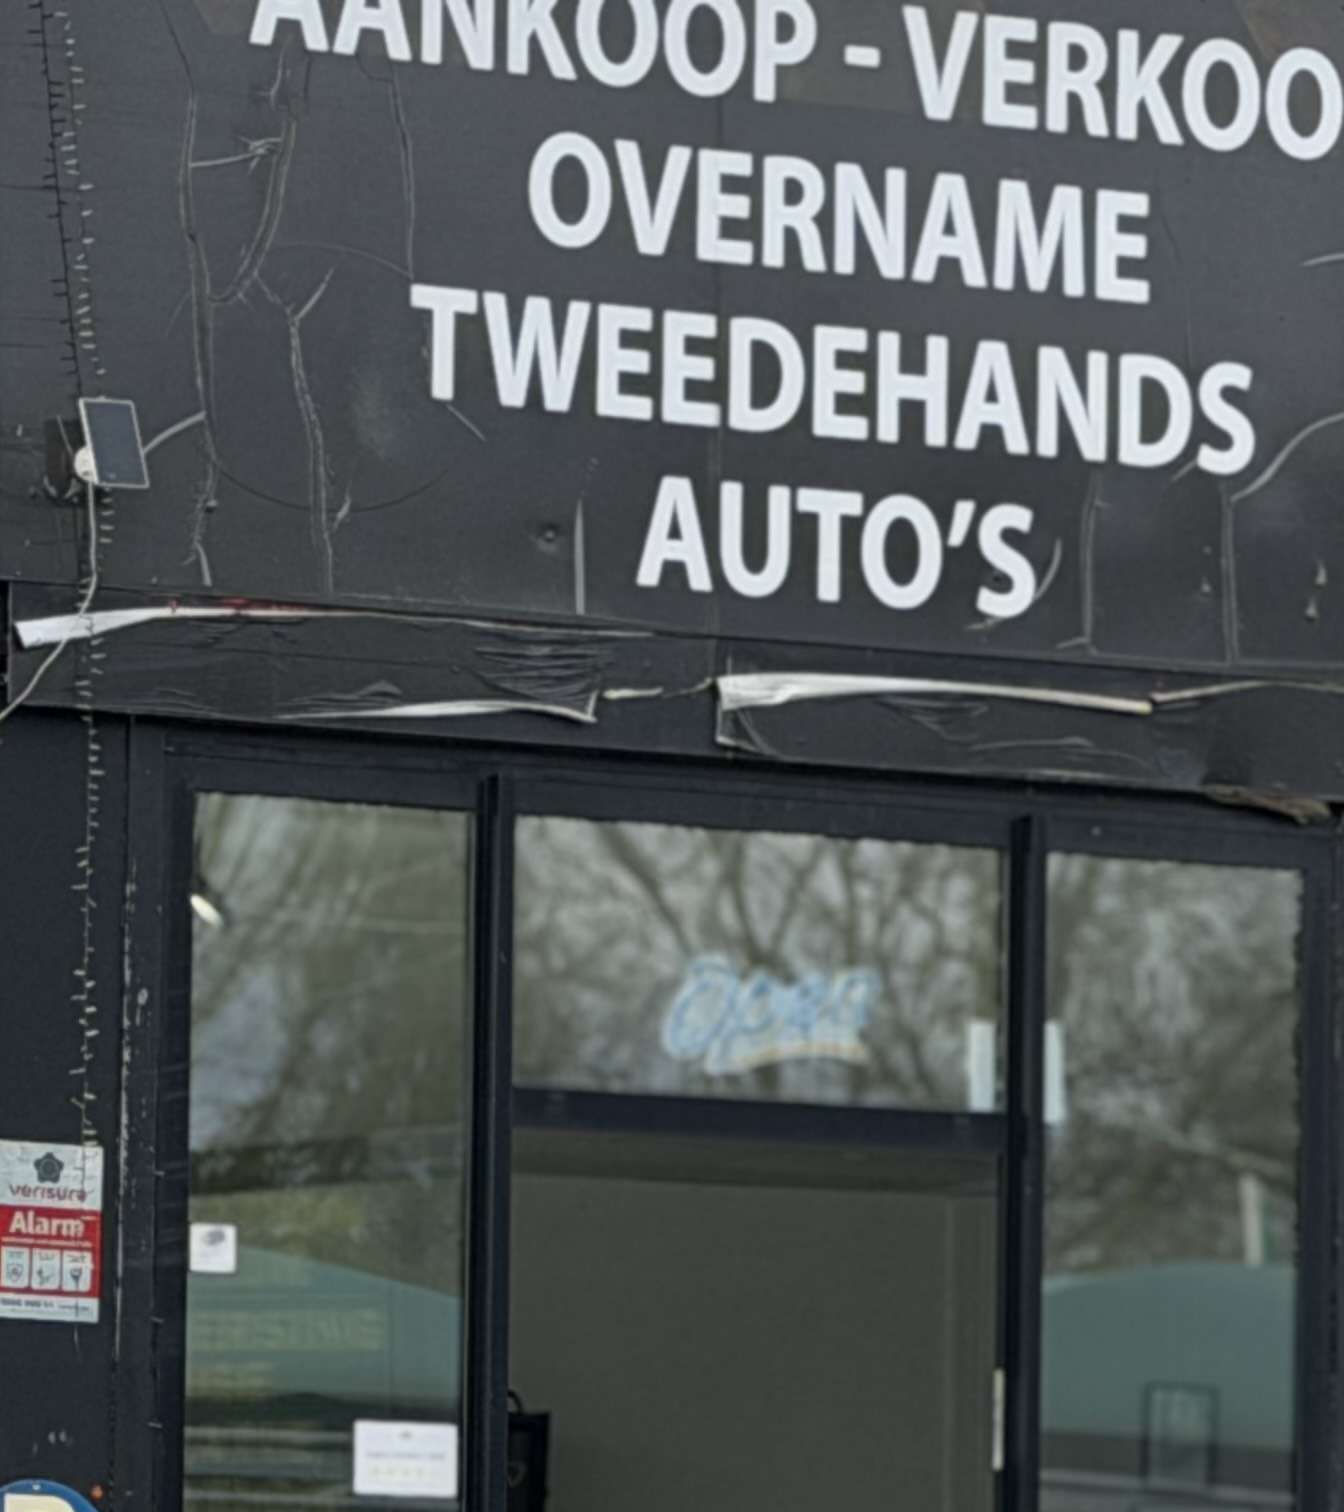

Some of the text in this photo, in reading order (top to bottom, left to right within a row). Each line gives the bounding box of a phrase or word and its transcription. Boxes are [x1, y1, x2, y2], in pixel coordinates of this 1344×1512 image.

[527, 132, 1150, 304] OVERNAME
[410, 284, 1258, 476] TWEEDEHANDS
[8, 1210, 85, 1237] Alarm
